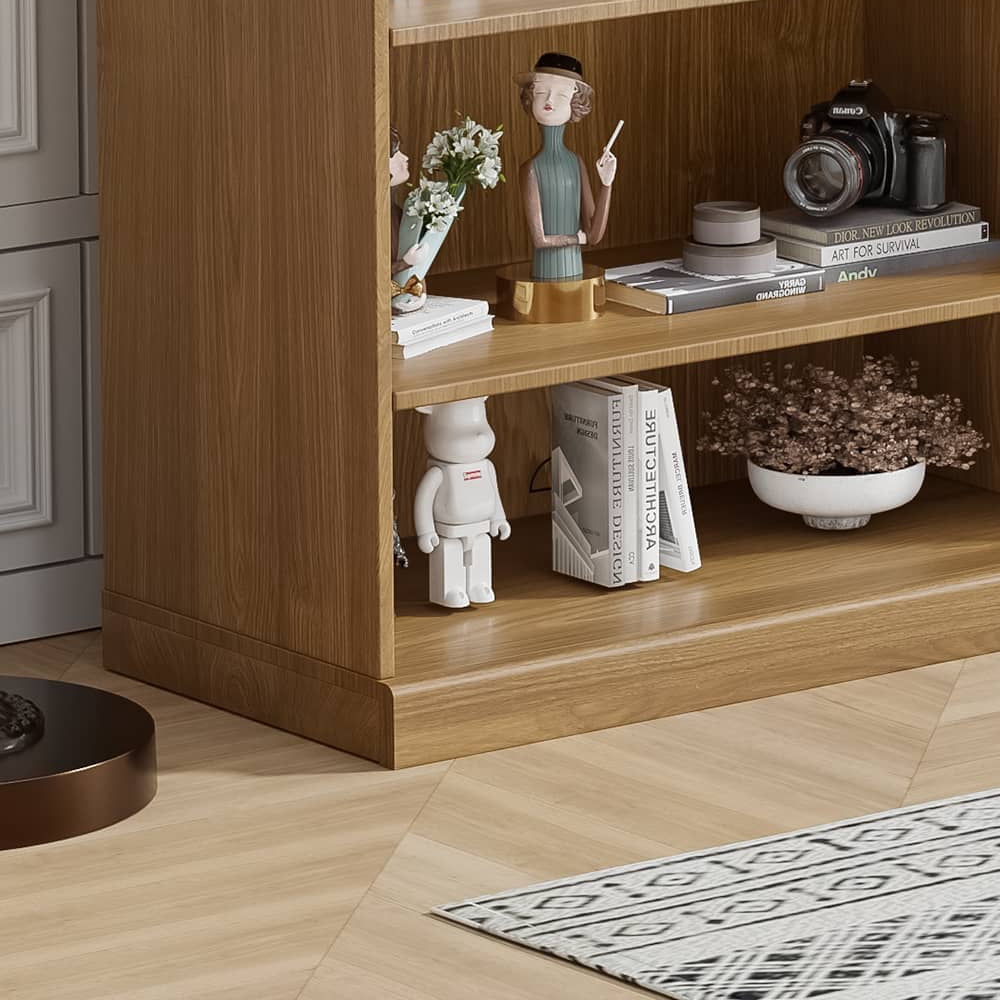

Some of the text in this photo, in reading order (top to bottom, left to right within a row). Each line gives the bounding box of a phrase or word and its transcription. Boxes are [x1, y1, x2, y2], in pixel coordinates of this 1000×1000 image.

[834, 211, 976, 245] DIOR. NEW LOOK REVOLUTION
[831, 238, 920, 262] ART FOR SURVIVAL
